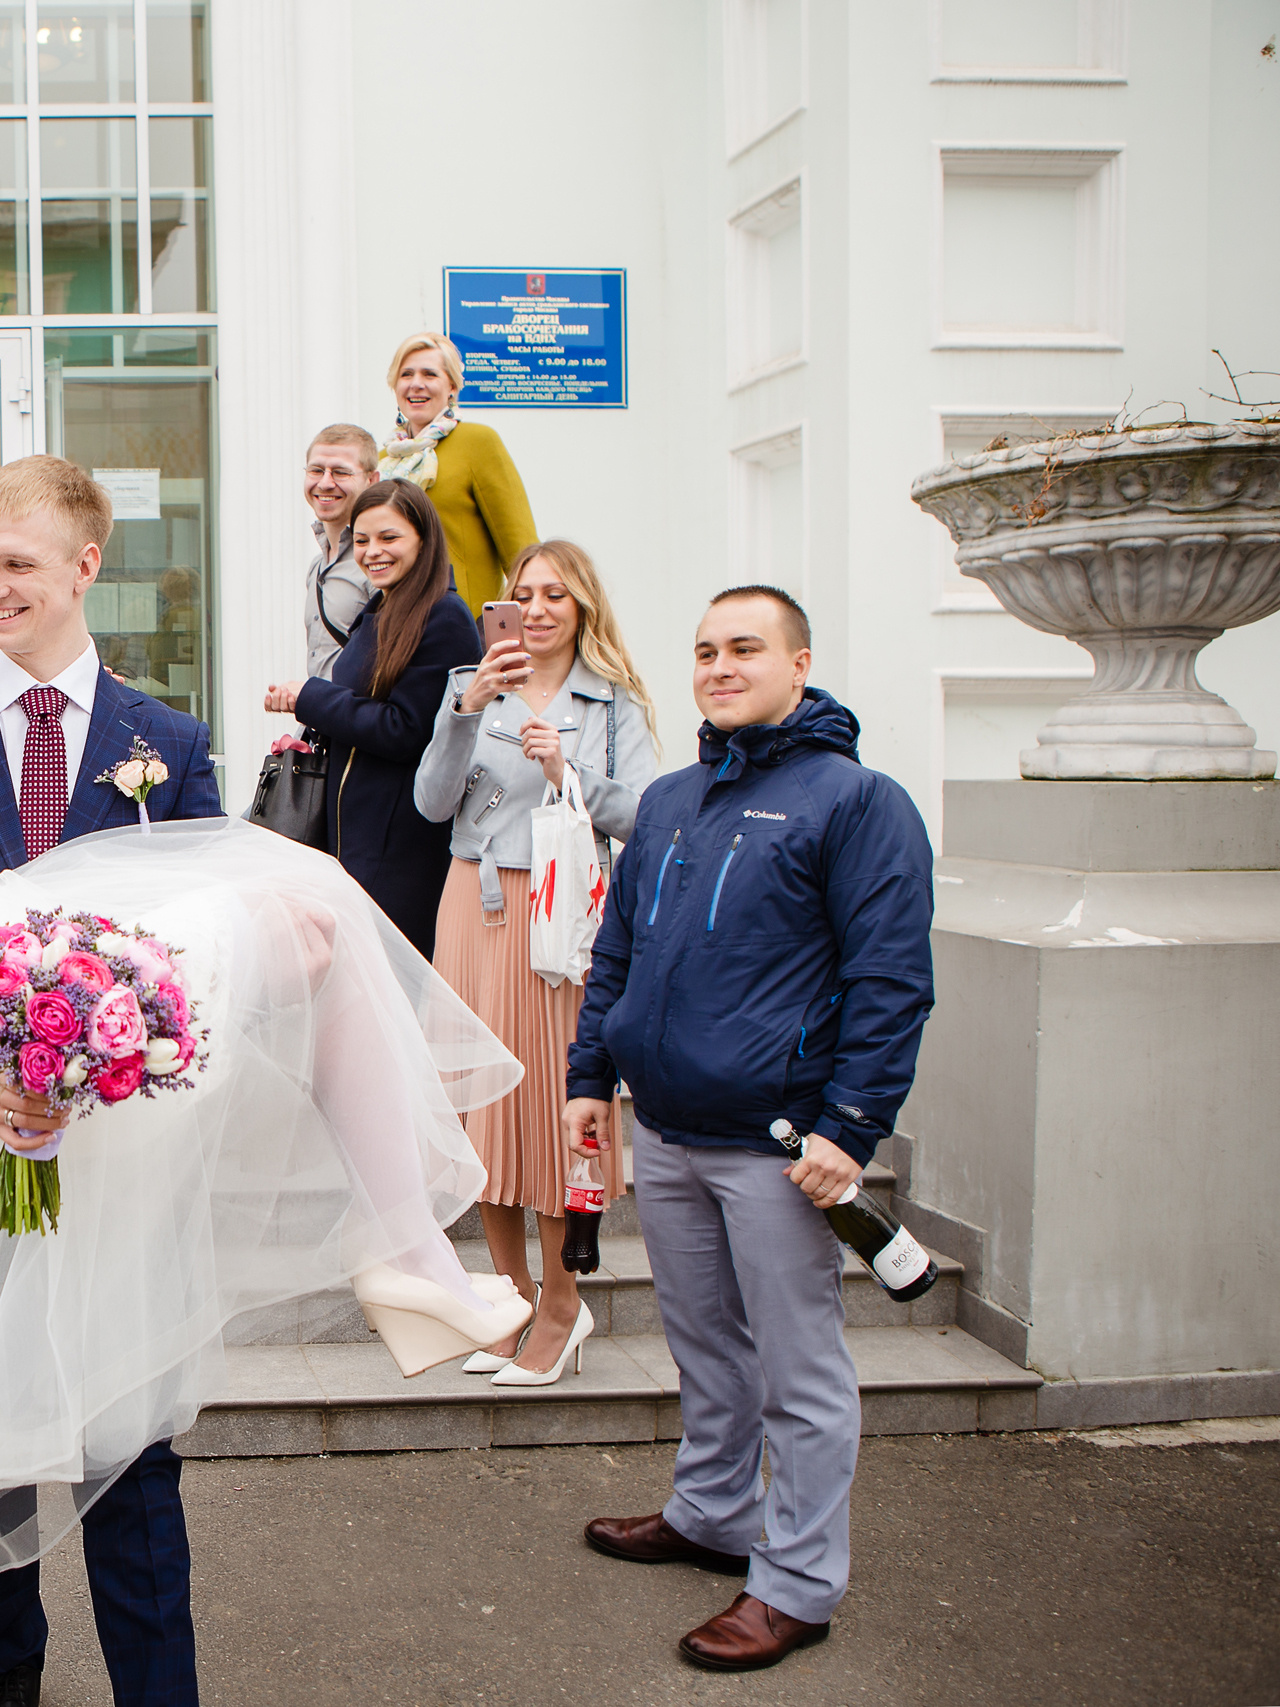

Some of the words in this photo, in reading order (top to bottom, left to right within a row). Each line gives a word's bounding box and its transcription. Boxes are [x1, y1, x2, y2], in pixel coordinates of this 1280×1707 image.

[512, 314, 559, 325] ДВОРЕЦ
[482, 324, 589, 335] БРАКОСОЧЕТАНИЯ
[508, 335, 522, 343] на
[524, 334, 556, 344] ВДНХ
[546, 358, 566, 366] 9.00
[582, 358, 607, 366] 18.00
[555, 393, 578, 401] ДЕНЬ
[751, 810, 787, 821] Columbia
